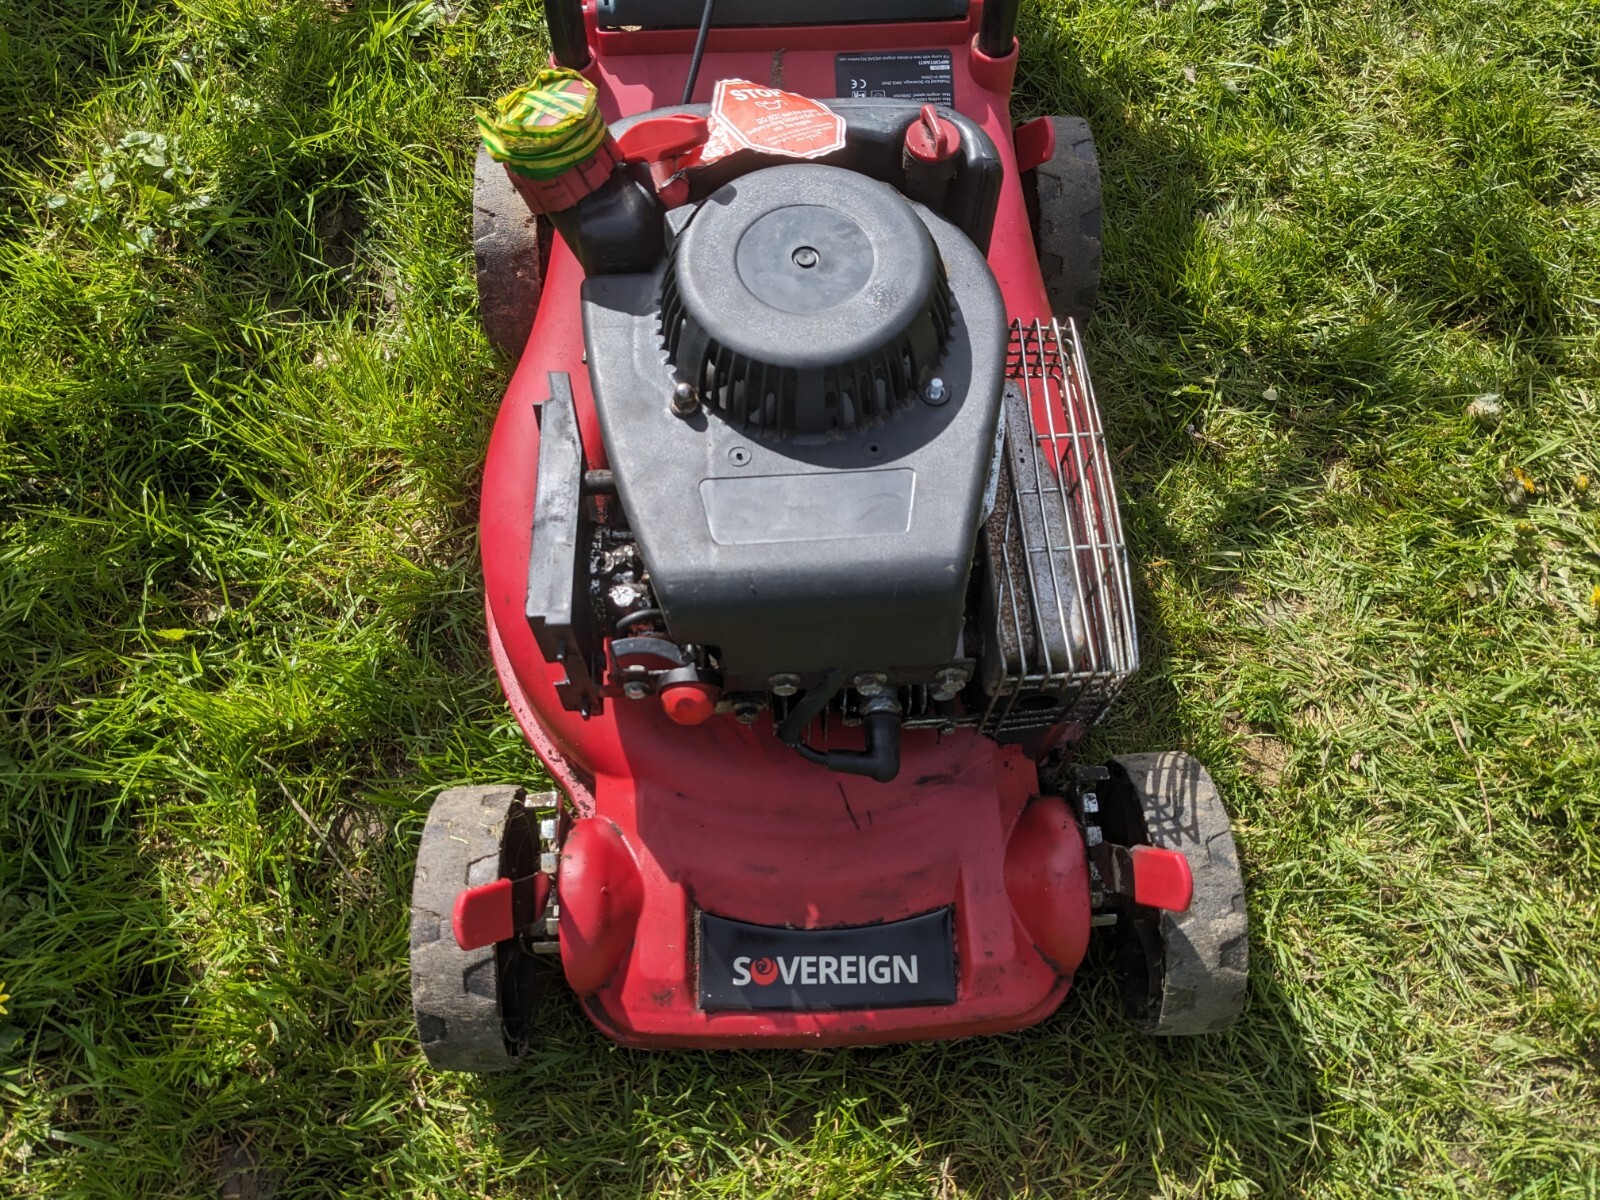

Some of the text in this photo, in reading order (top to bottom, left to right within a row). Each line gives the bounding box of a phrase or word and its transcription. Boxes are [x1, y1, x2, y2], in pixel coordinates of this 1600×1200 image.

[851, 79, 866, 89] CE
[729, 88, 781, 101] STOP
[756, 117, 767, 125] DO
[767, 113, 782, 122] NOT
[746, 125, 765, 135] before
[732, 954, 919, 987] SOVEREIGN
